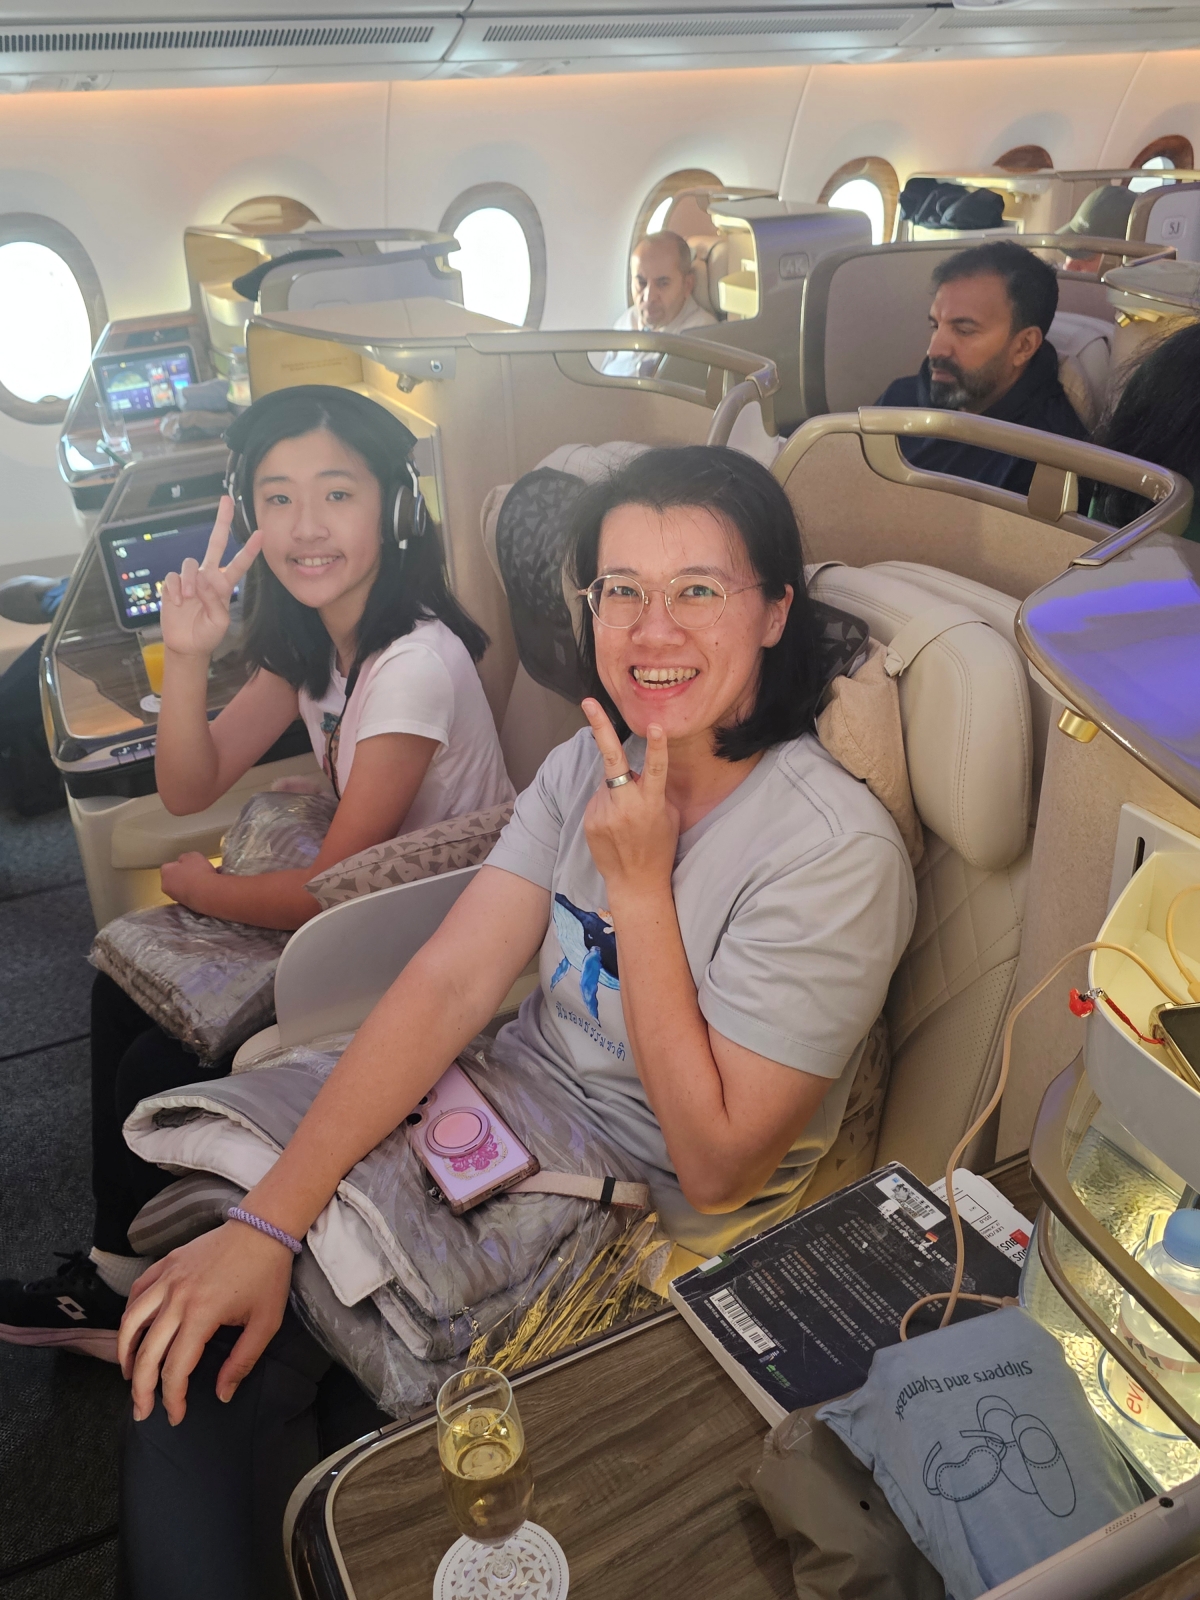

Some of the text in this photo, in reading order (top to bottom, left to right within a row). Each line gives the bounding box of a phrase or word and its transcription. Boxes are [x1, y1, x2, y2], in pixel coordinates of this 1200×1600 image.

[997, 1237, 1019, 1254] BUS
[894, 1360, 1034, 1422] Slippers and Eyemask
[1125, 1374, 1145, 1415] evi
